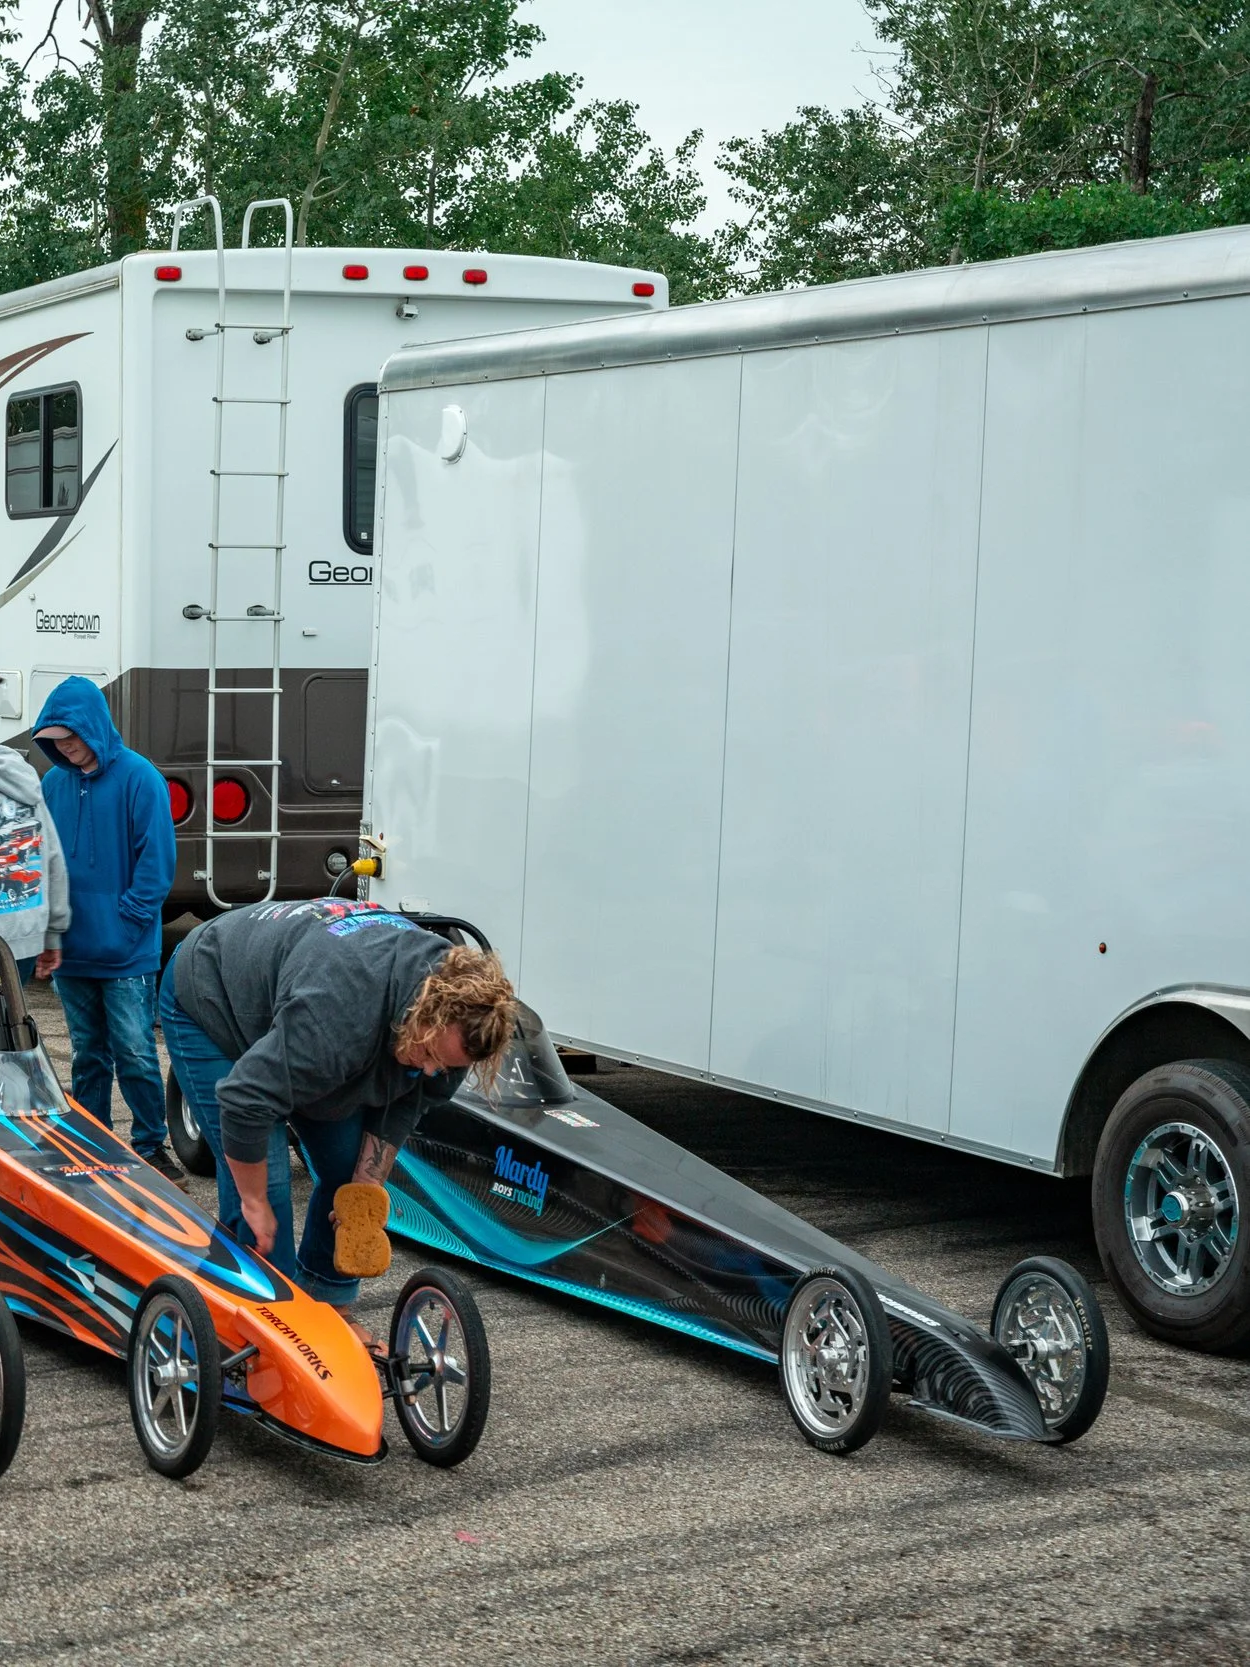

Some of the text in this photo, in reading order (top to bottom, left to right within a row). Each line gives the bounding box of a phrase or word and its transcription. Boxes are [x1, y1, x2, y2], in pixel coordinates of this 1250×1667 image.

[36, 609, 100, 634] Georgetown
[494, 1145, 549, 1200] Mardy
[492, 1182, 544, 1217] BOYS racing
[876, 1292, 941, 1327] CHWORKS
[256, 1306, 333, 1380] TORCHWORKS
